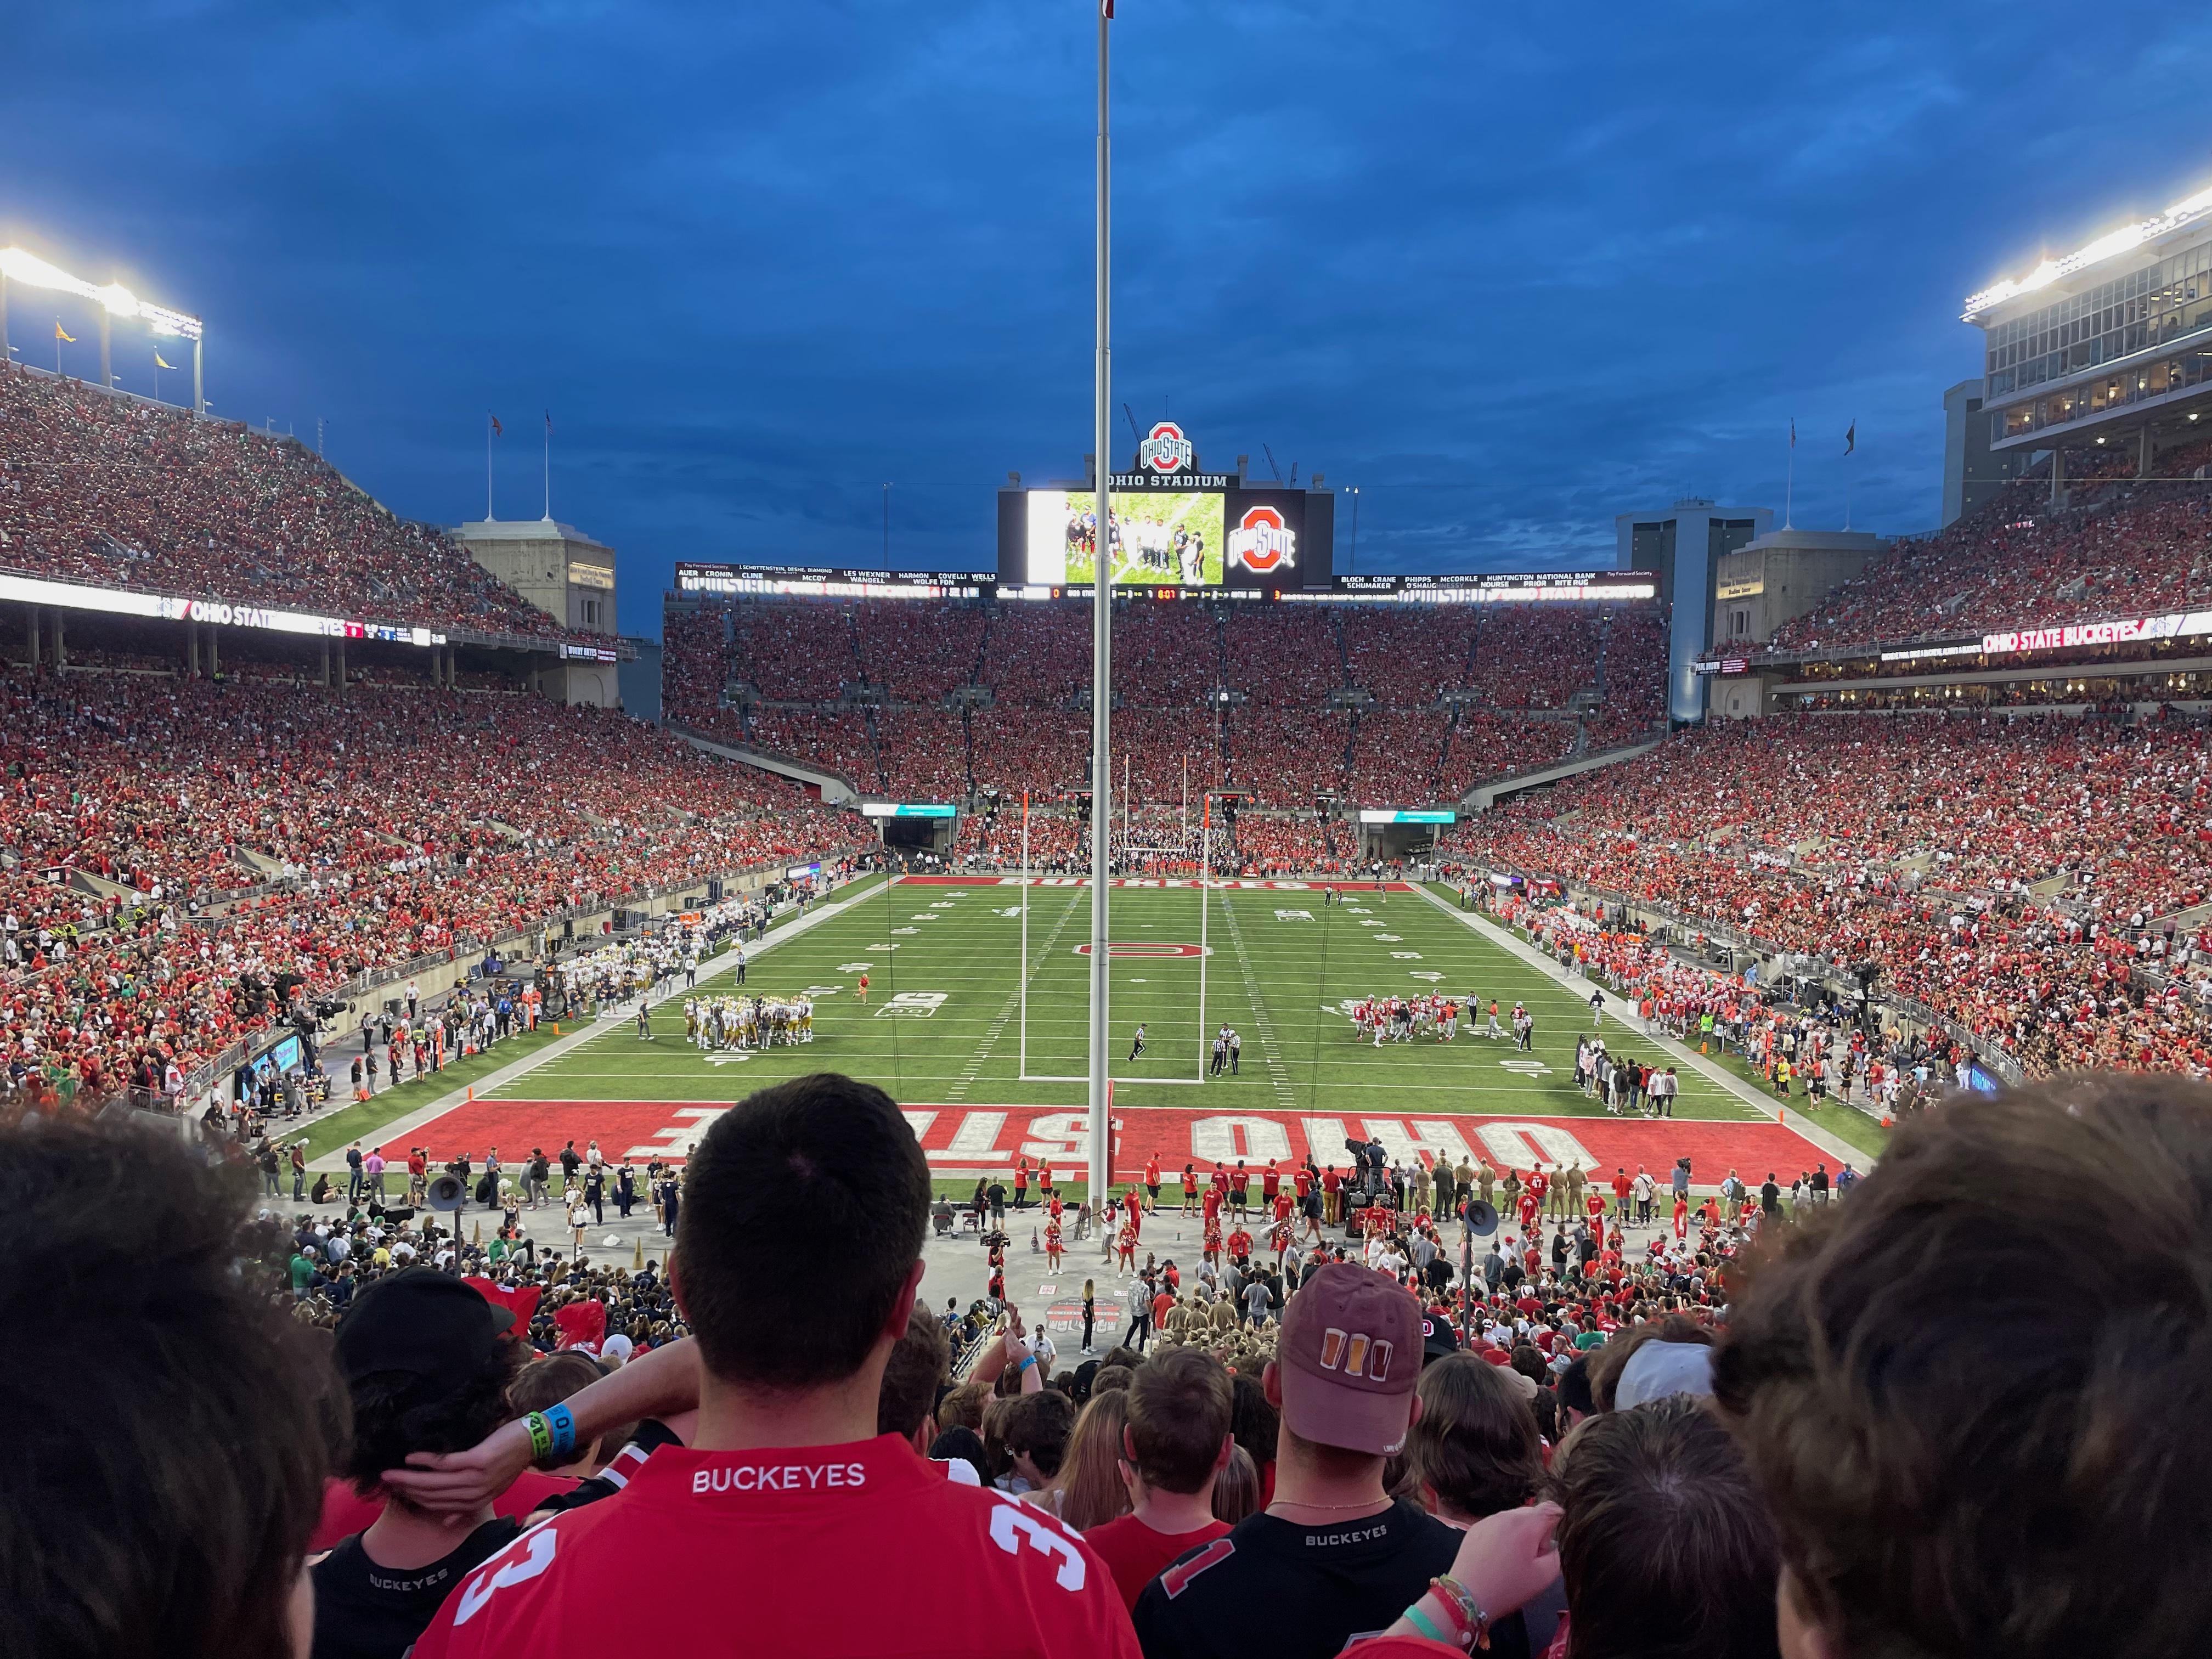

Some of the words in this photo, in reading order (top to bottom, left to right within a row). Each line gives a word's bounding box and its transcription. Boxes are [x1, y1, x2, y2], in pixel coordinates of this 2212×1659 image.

[1150, 475, 1227, 487] STADIUM
[190, 601, 233, 625] OHIO
[1983, 633, 2018, 653] OHIO
[2020, 628, 2062, 650] STATE
[2063, 620, 2139, 646] BUCKEYES
[622, 1108, 1124, 1162] STE
[1191, 1115, 1602, 1172] OHIO
[1531, 1178, 1542, 1188] 47
[692, 1462, 866, 1493] BUCKEYES
[1306, 1525, 1387, 1546] BUCKEYES
[370, 1568, 448, 1591] BUCKEYES
